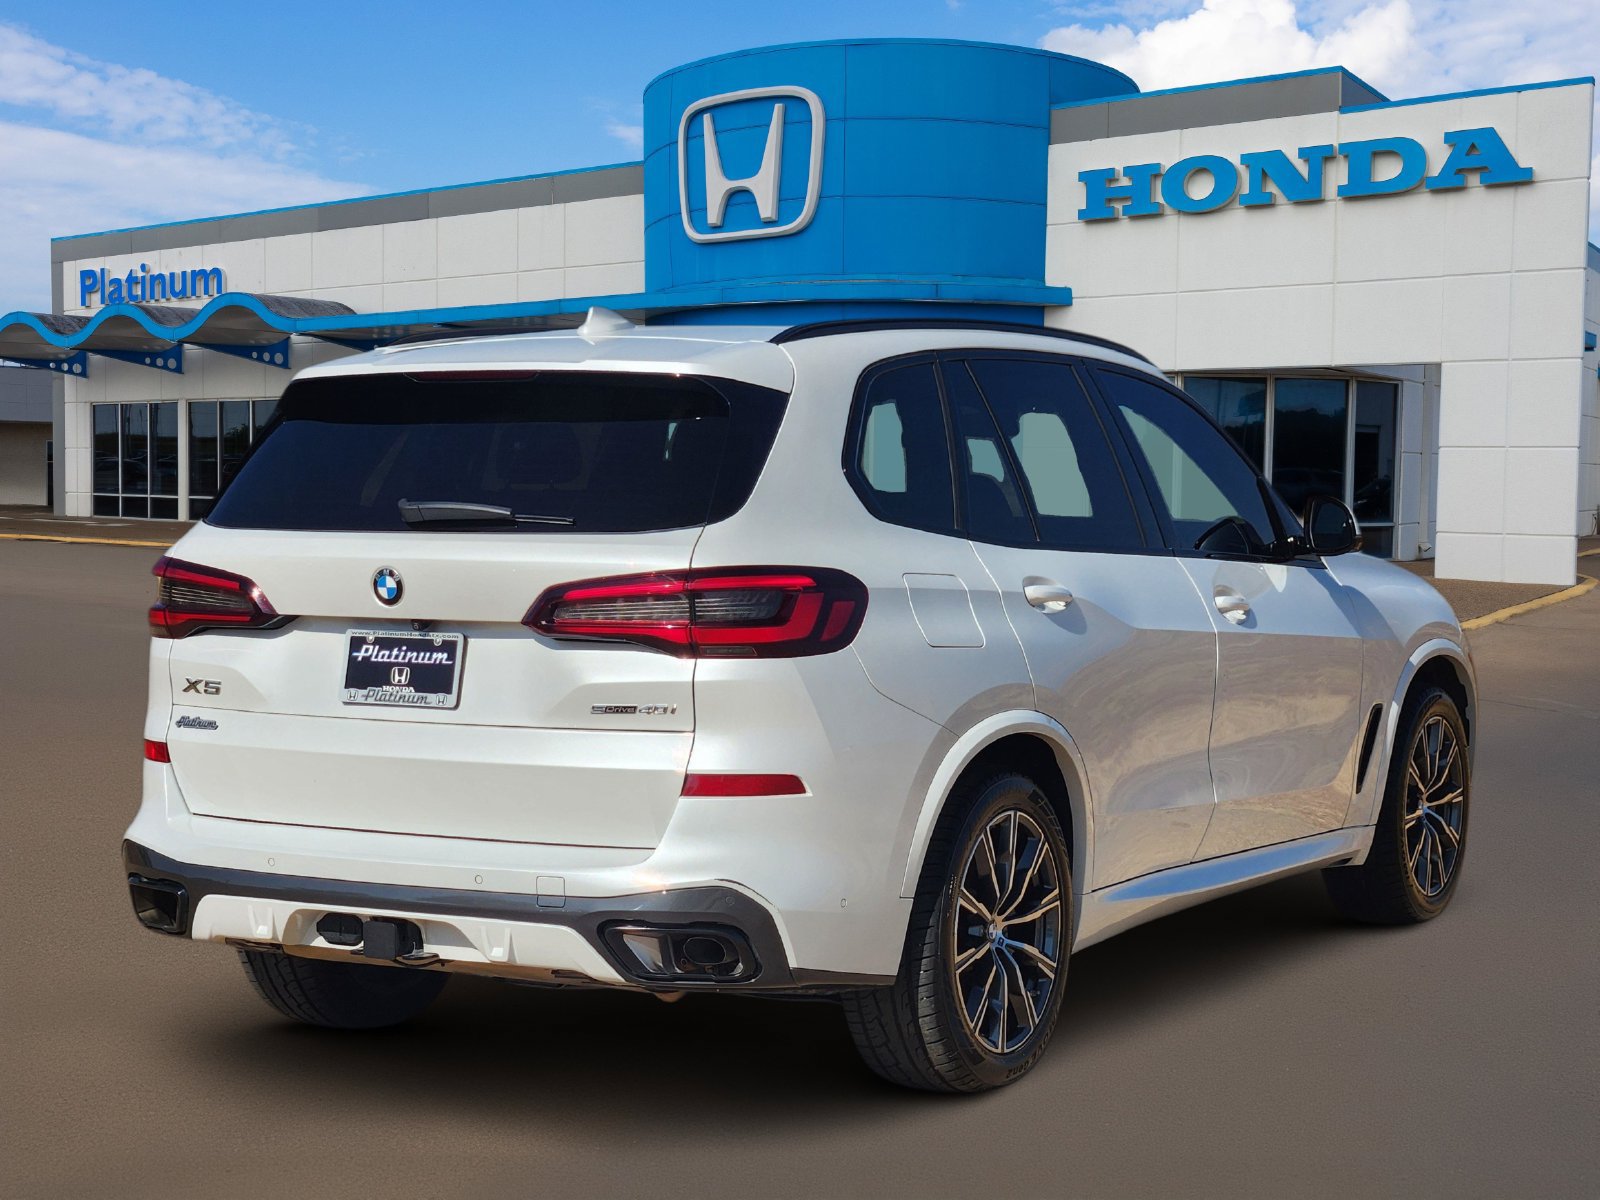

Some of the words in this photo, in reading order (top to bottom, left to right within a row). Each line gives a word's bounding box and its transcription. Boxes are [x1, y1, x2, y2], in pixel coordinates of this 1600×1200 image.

[1077, 126, 1534, 221] HONDA
[79, 262, 225, 307] Platinum
[375, 568, 400, 582] BMW
[351, 645, 453, 664] Platinum
[182, 677, 222, 695] X5
[381, 685, 415, 693] HONDA
[361, 686, 432, 705] Platinum
[175, 715, 219, 730] Platinum
